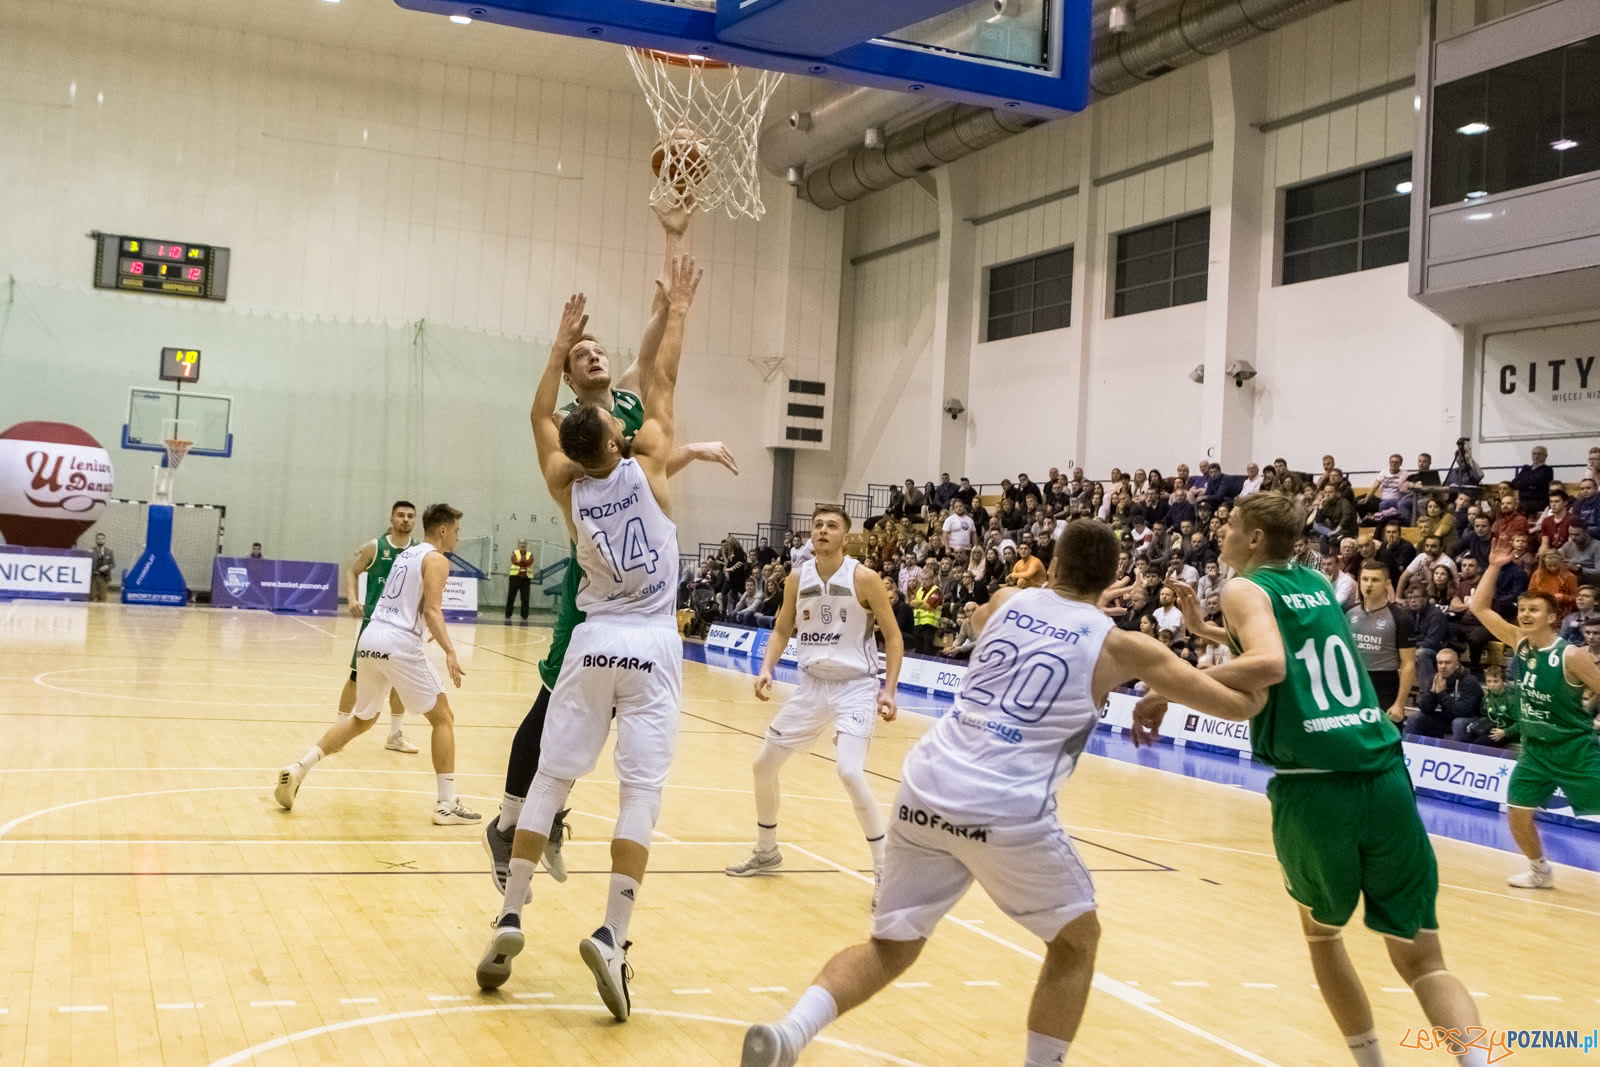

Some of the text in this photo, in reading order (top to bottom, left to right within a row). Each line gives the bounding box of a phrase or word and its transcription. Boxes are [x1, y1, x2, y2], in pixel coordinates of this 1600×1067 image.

[182, 362, 192, 376] 7
[1500, 356, 1595, 394] CITY
[592, 517, 658, 583] 14
[0, 564, 82, 584] NICKEL
[821, 605, 832, 624] 5
[1003, 609, 1080, 645] POZnan
[583, 654, 652, 673] BIOFARM
[1548, 649, 1560, 667] 6
[937, 672, 961, 687] POZn
[961, 639, 1068, 723] 20
[1295, 634, 1361, 711] 10
[1201, 719, 1249, 740] NICKEL
[1420, 759, 1500, 792] POZnan
[899, 805, 988, 844] BIOFARM
